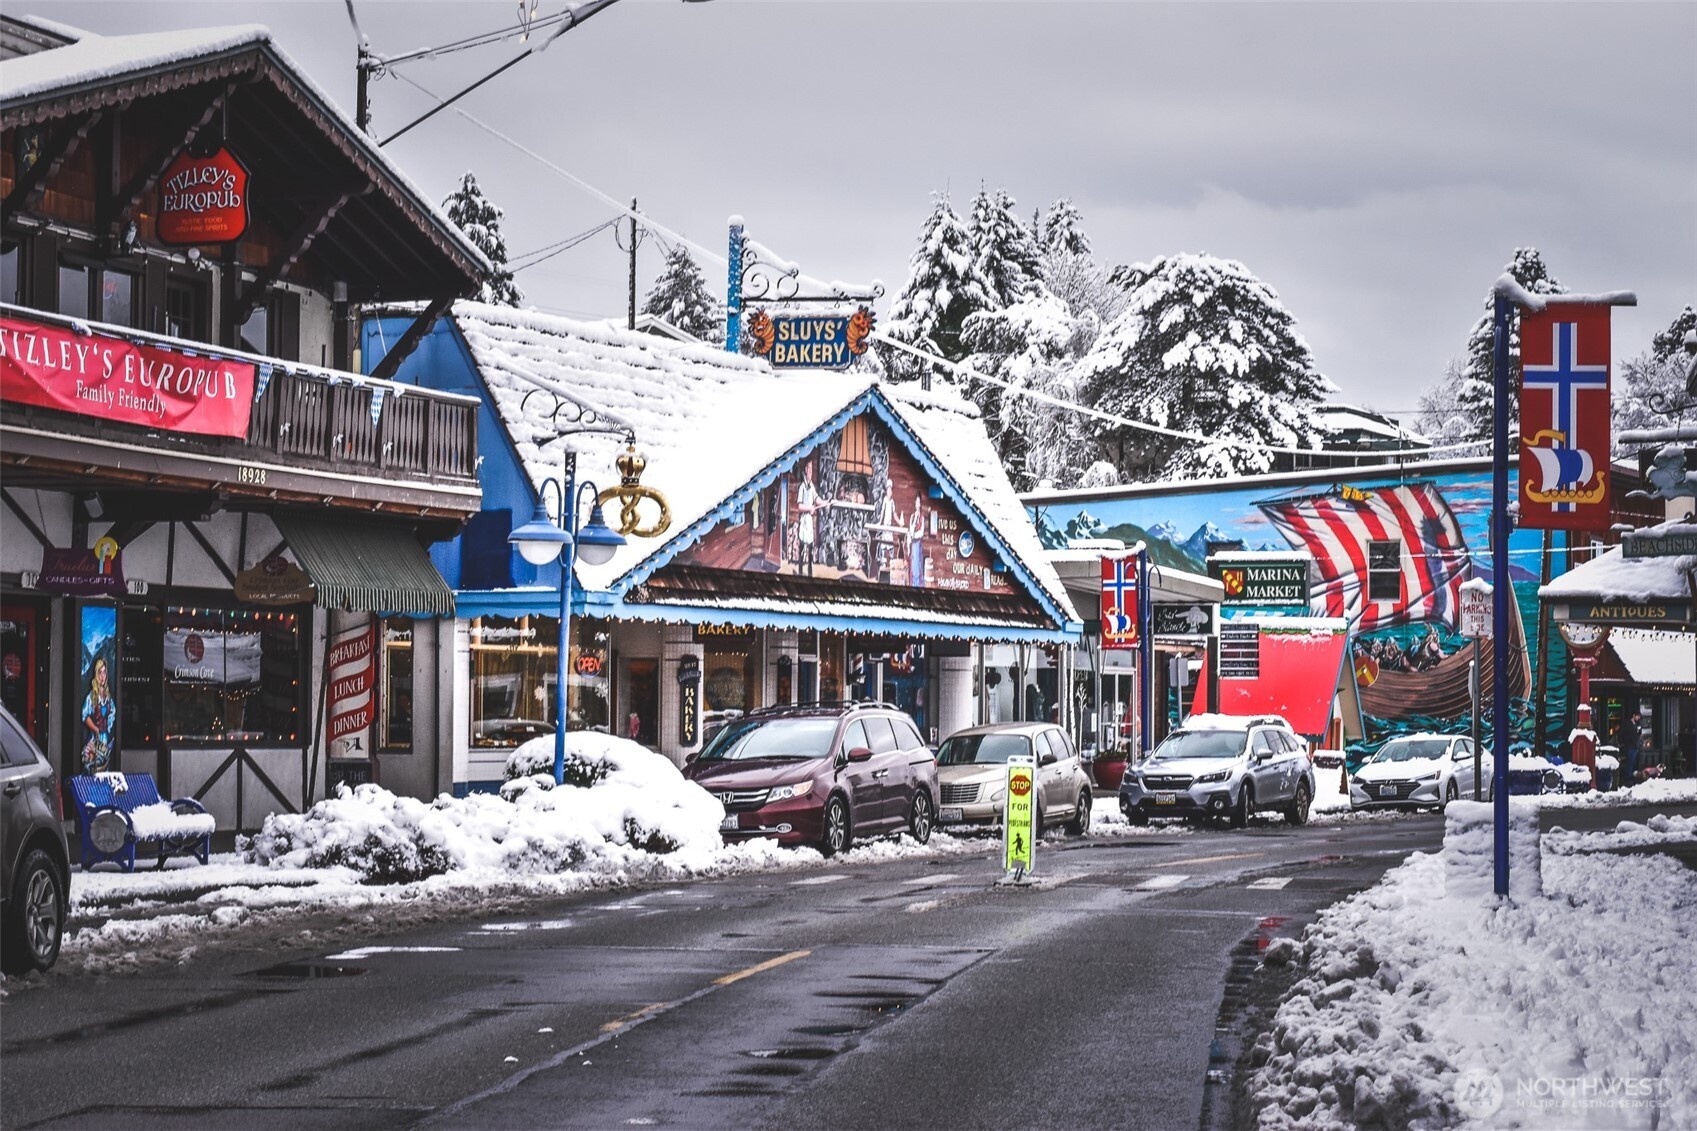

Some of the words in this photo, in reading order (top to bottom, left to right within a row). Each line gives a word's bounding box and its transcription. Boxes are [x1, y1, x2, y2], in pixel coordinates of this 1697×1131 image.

[166, 166, 236, 194] TIZLEY'S
[778, 320, 843, 341] SLUYS'
[774, 341, 846, 364] BAKERY
[124, 354, 238, 400] EUROPUB
[75, 379, 115, 409] Family
[118, 388, 167, 419] Friendly
[238, 466, 267, 485] 18928
[89, 576, 115, 585] GIFTS
[1246, 567, 1301, 582] MARINA
[1246, 584, 1302, 598] MARKET
[1471, 592, 1484, 603] NO
[1470, 615, 1485, 623] THIS
[1589, 606, 1667, 618] ANTIQUES
[697, 624, 751, 636] BAKERY
[329, 634, 371, 667] BREAKFAST
[577, 655, 601, 673] OPEN
[334, 675, 365, 700] LUNCH
[333, 710, 369, 736] DINNER
[684, 686, 695, 742] BAKERY
[1011, 780, 1030, 791] STOP
[1011, 802, 1029, 812] FOR
